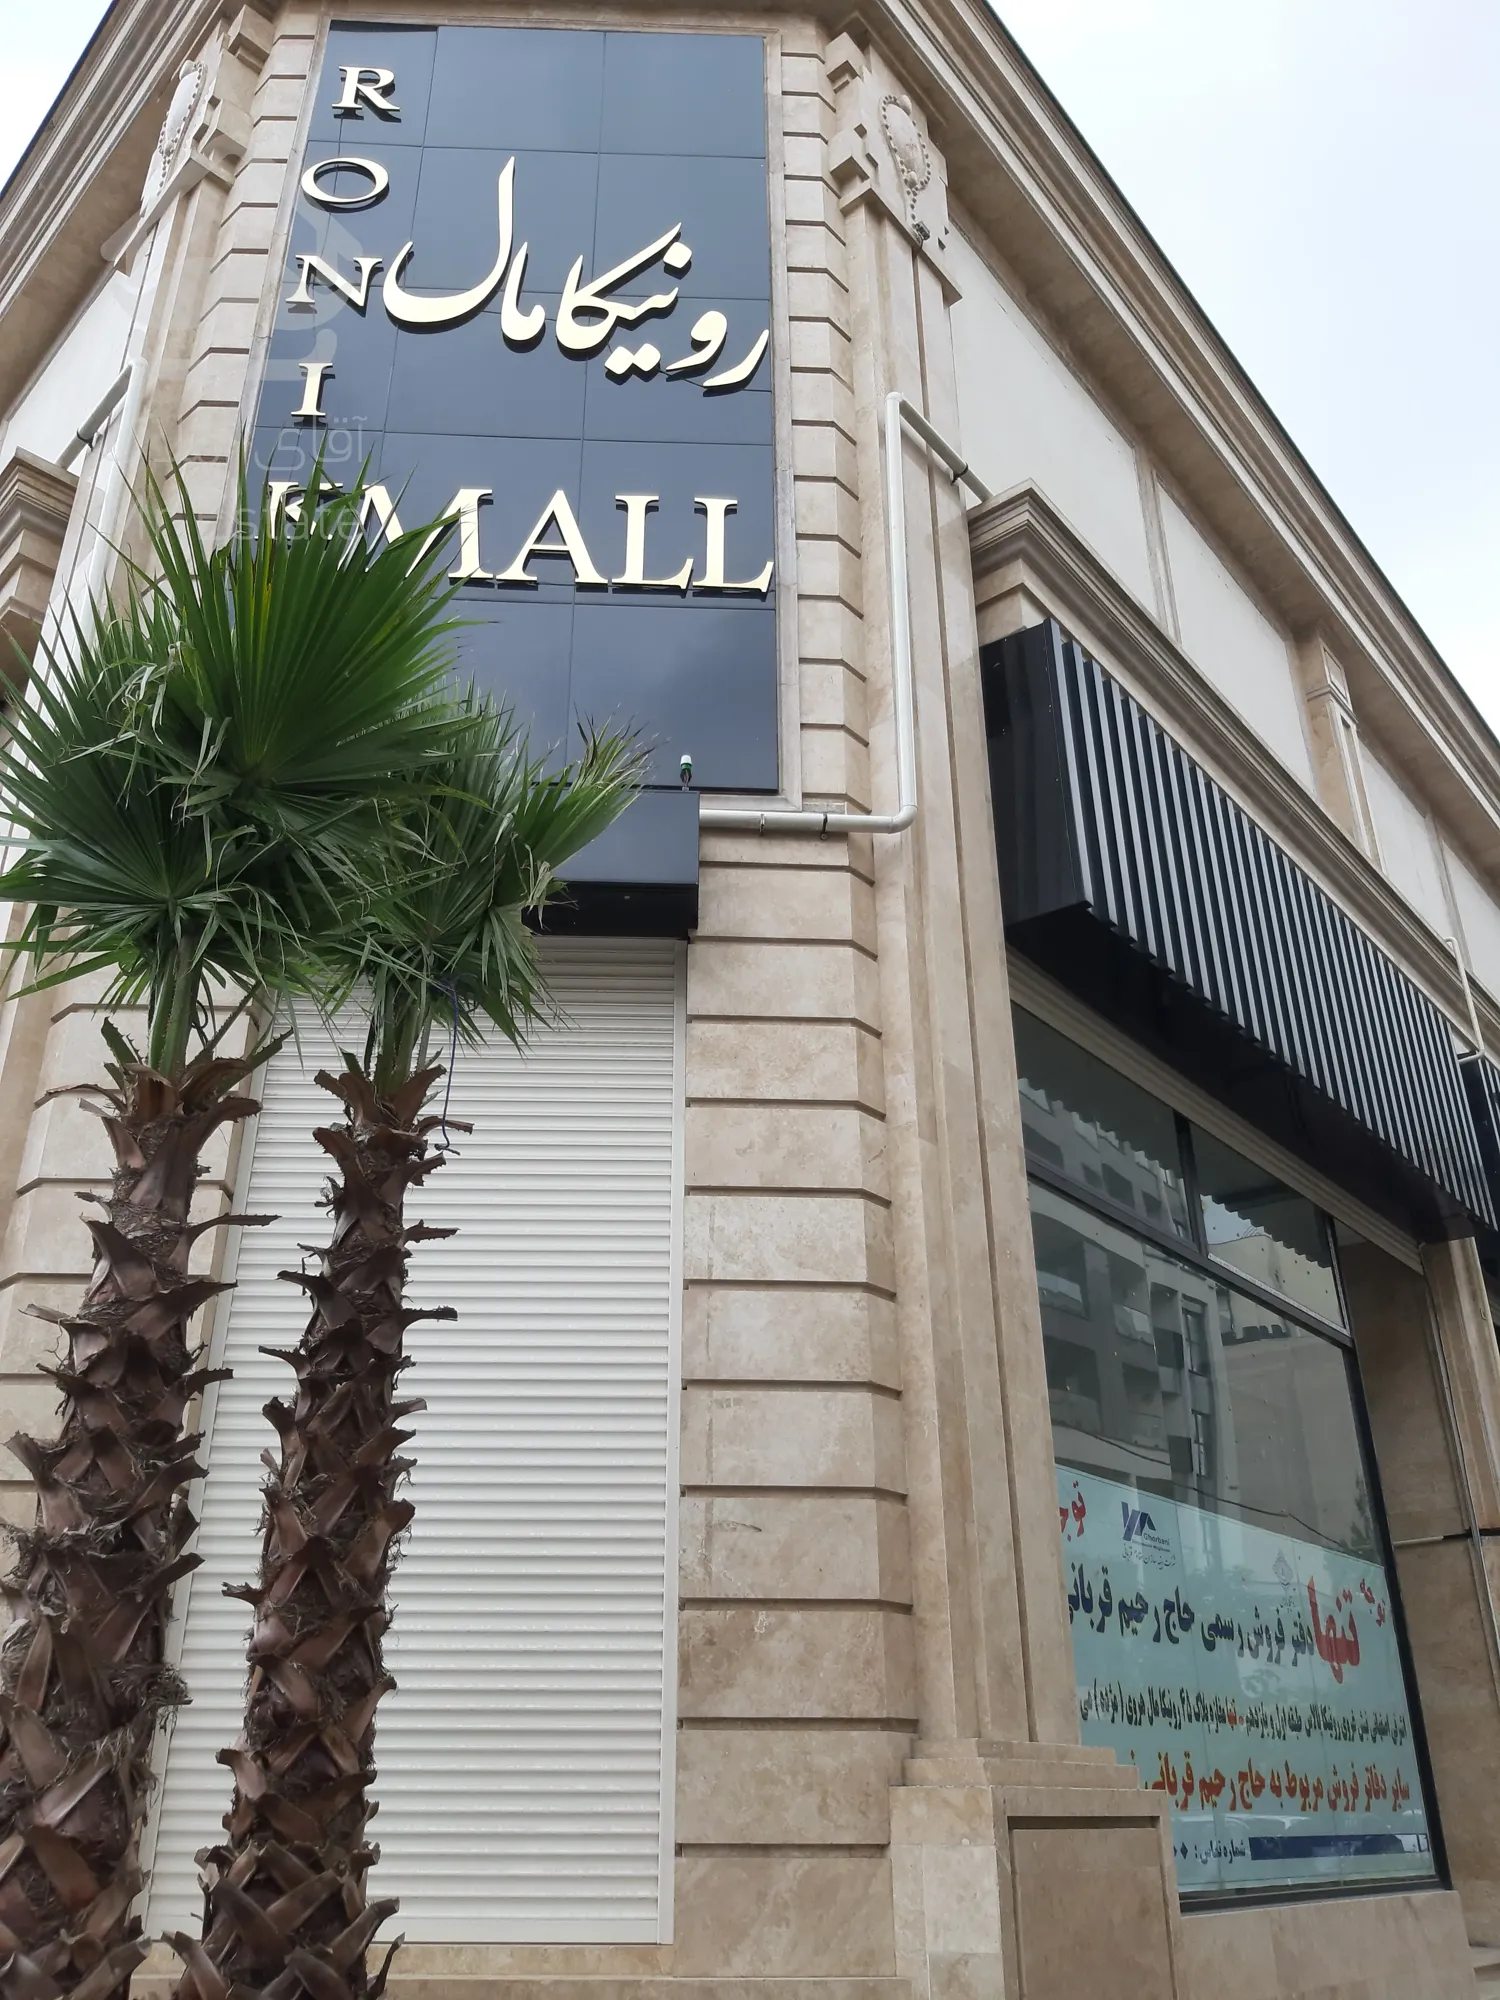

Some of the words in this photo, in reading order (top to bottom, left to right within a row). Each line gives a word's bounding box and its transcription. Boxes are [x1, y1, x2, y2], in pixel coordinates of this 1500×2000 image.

[382, 156, 546, 342] مال
[555, 222, 769, 388] رونیکا
[335, 484, 774, 593] MALL
[1117, 1591, 1161, 1643] رحیم
[1163, 1584, 1195, 1645] حاج
[1360, 1578, 1386, 1628] توجه
[1200, 1613, 1244, 1658] رسمی
[1247, 1604, 1286, 1665] فروش
[1291, 1610, 1314, 1667] دفتر
[1307, 1575, 1360, 1684] تنها
[1198, 1767, 1237, 1811] رحیم
[1237, 1757, 1266, 1810] حاج
[1269, 1767, 1283, 1810] به
[1284, 1759, 1324, 1812] مربوط
[1326, 1761, 1360, 1812] فروش
[1364, 1763, 1388, 1812] دفاتر
[1391, 1766, 1411, 1812] سایر
[1222, 1839, 1246, 1864] شماره
